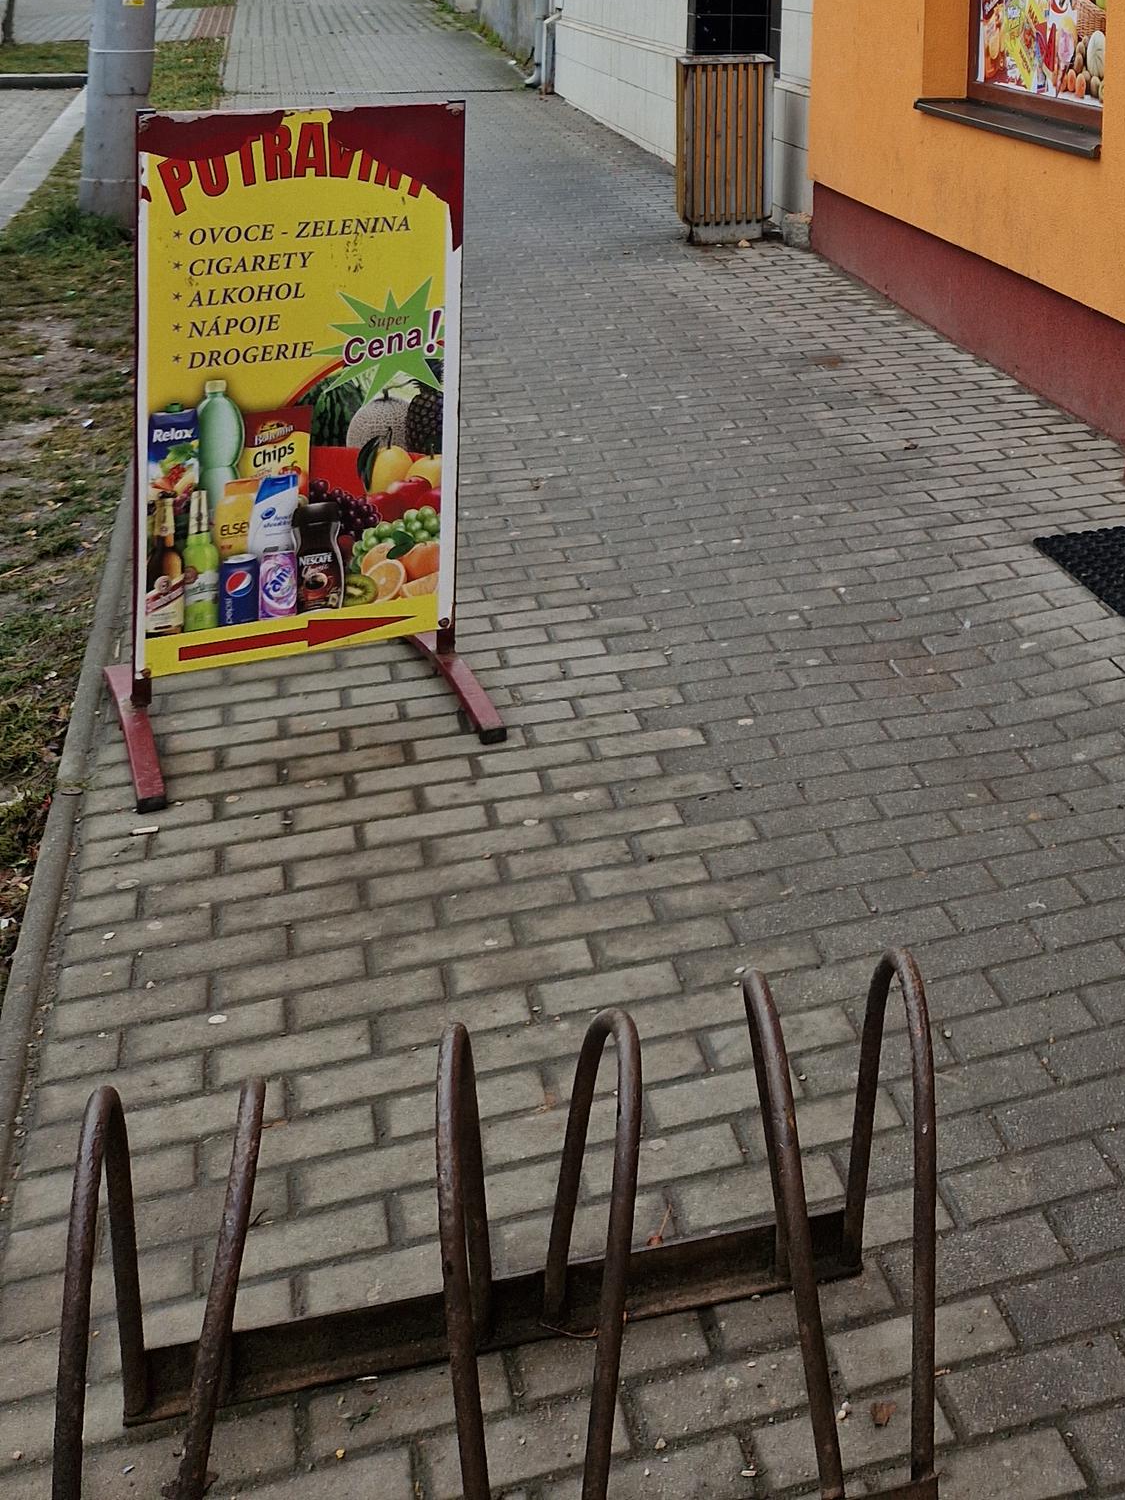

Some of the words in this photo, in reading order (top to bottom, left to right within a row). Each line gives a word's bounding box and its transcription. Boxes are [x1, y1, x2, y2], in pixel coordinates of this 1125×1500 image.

[189, 223, 275, 246] OVOCE
[296, 215, 411, 239] ZELENINA
[188, 251, 314, 277] CIGARETY
[187, 282, 306, 308] ALKOHOL
[187, 314, 281, 338] NÁPOJE
[368, 314, 410, 331] Super
[344, 309, 442, 365] Cena!
[187, 341, 315, 370] DROGERIE
[152, 428, 194, 443] Relax
[253, 442, 295, 468] Chips
